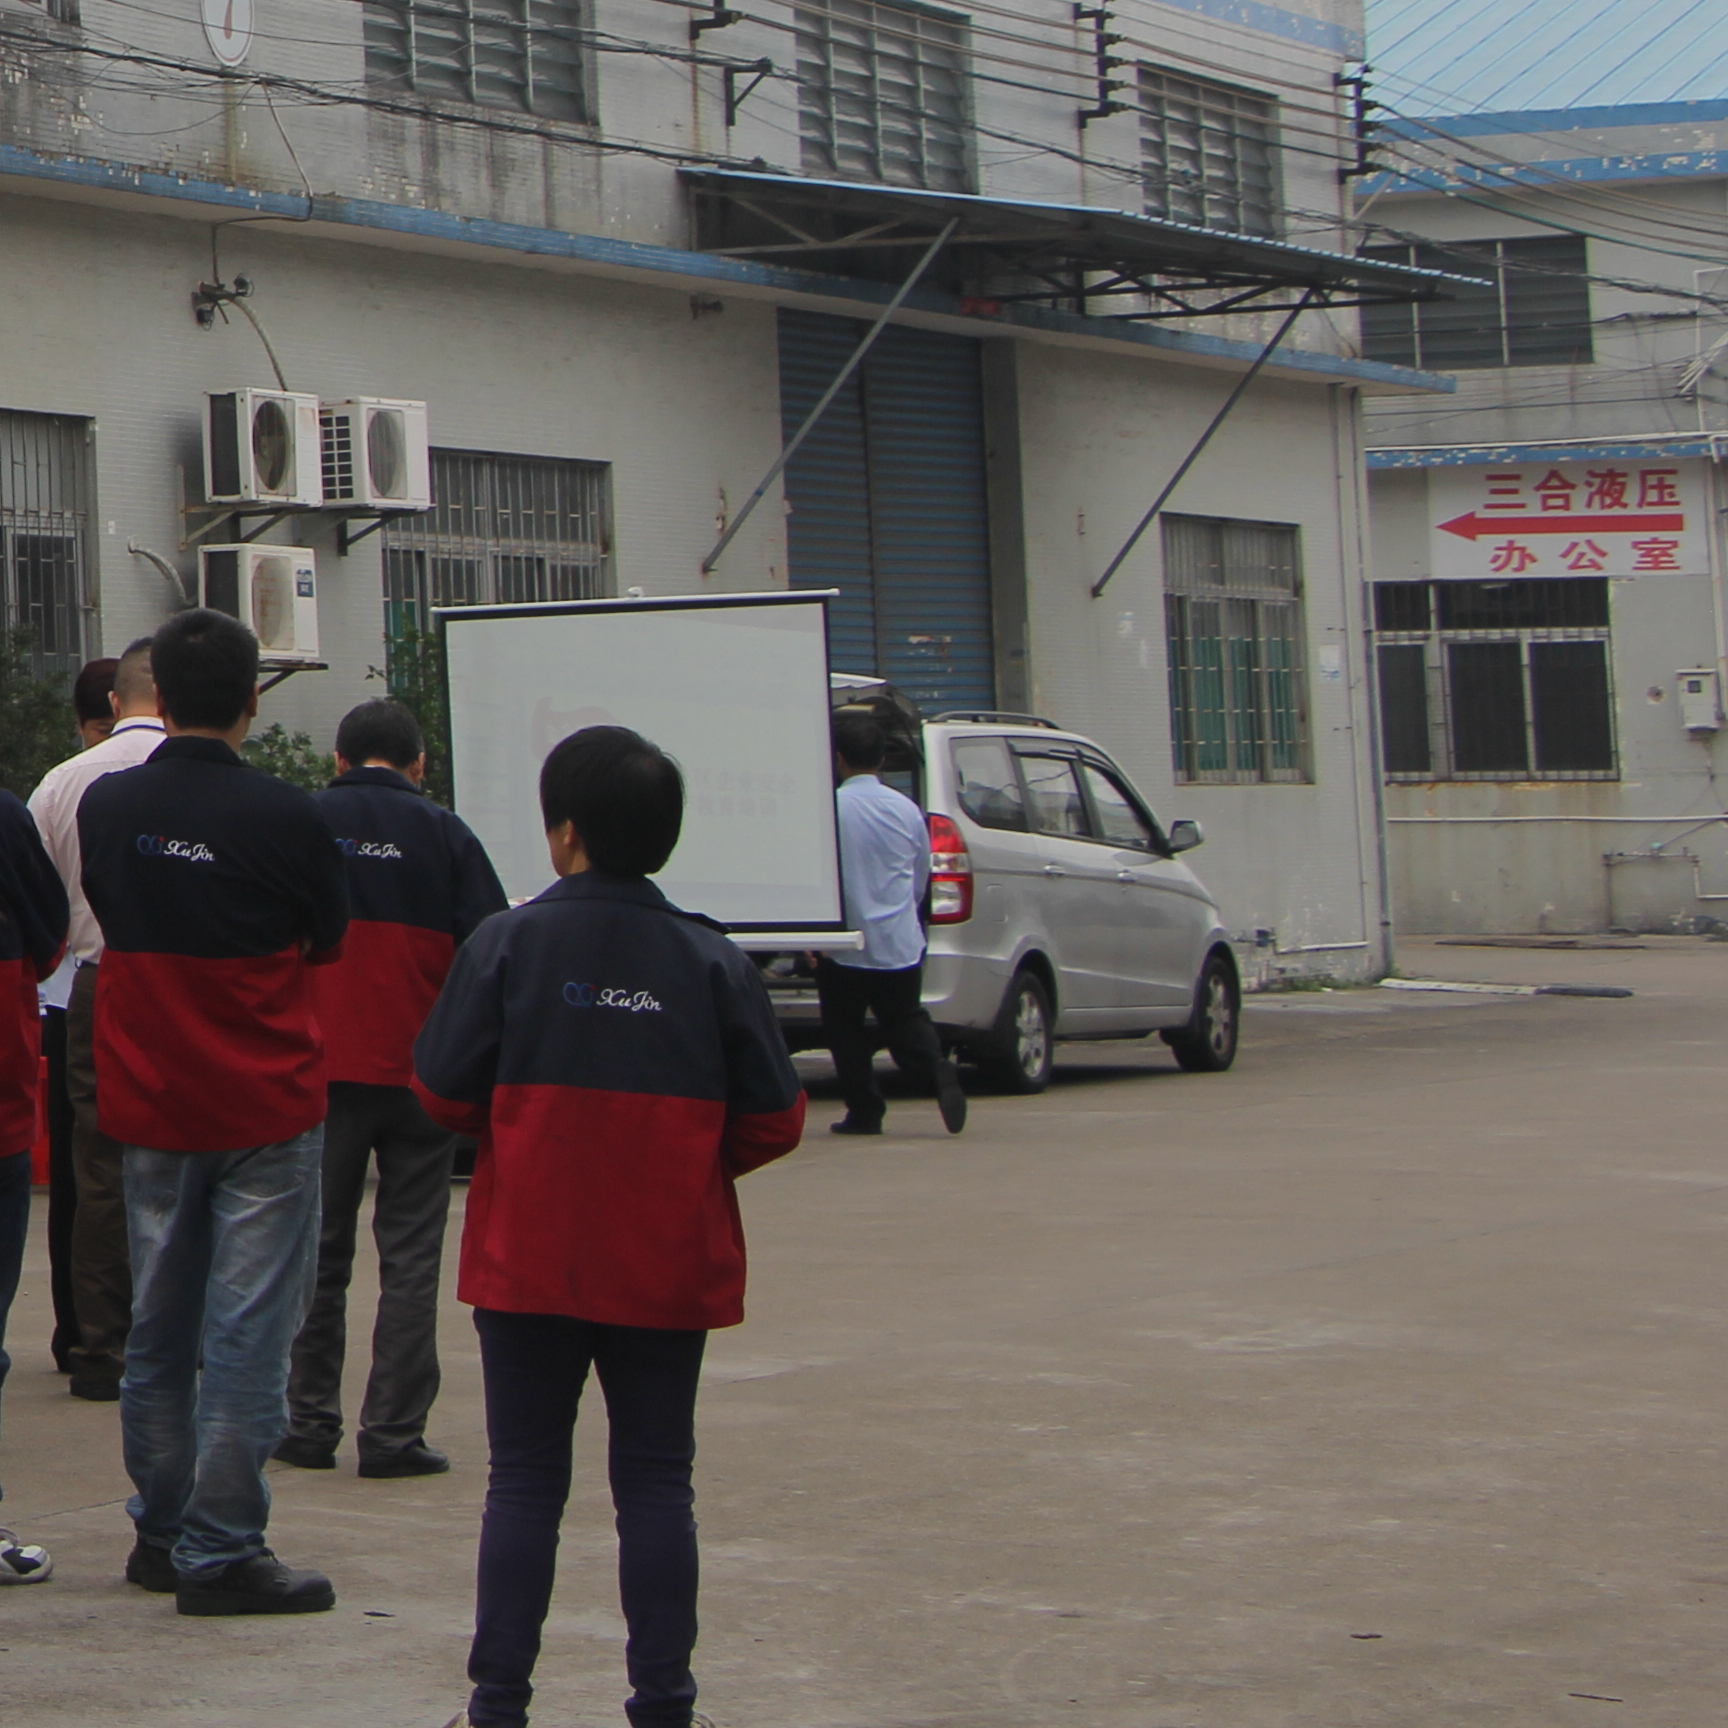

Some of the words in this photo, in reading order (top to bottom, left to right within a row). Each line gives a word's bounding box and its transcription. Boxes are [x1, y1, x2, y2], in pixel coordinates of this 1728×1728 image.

[1483, 467, 1681, 512] 三合液压
[1489, 537, 1681, 573] 办公室
